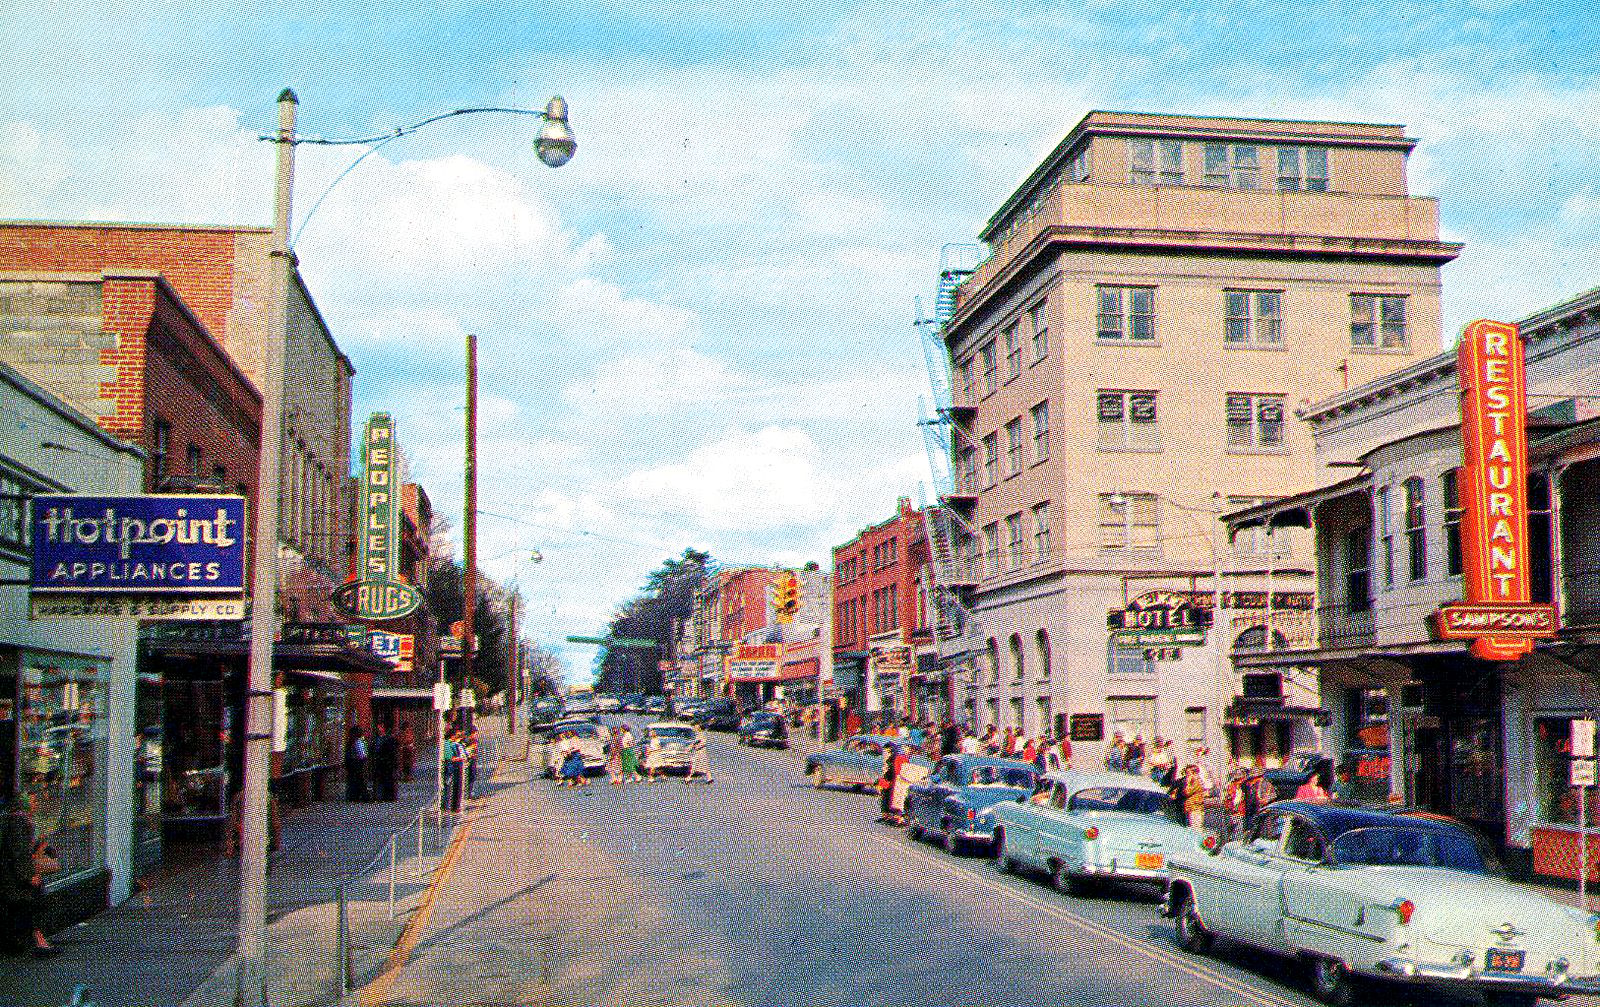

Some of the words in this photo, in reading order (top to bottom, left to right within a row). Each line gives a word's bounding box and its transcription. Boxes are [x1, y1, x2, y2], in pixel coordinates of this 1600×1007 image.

[1485, 332, 1516, 597] RESTAURANT
[368, 427, 389, 573] PEOPLES
[40, 508, 236, 560] Hotpoint
[51, 562, 221, 581] APPLIANCES
[149, 603, 207, 616] SUPPLY
[343, 585, 413, 614] DRUGS
[1124, 608, 1190, 627] HOTEL
[1451, 610, 1549, 629] SAMPSON'S
